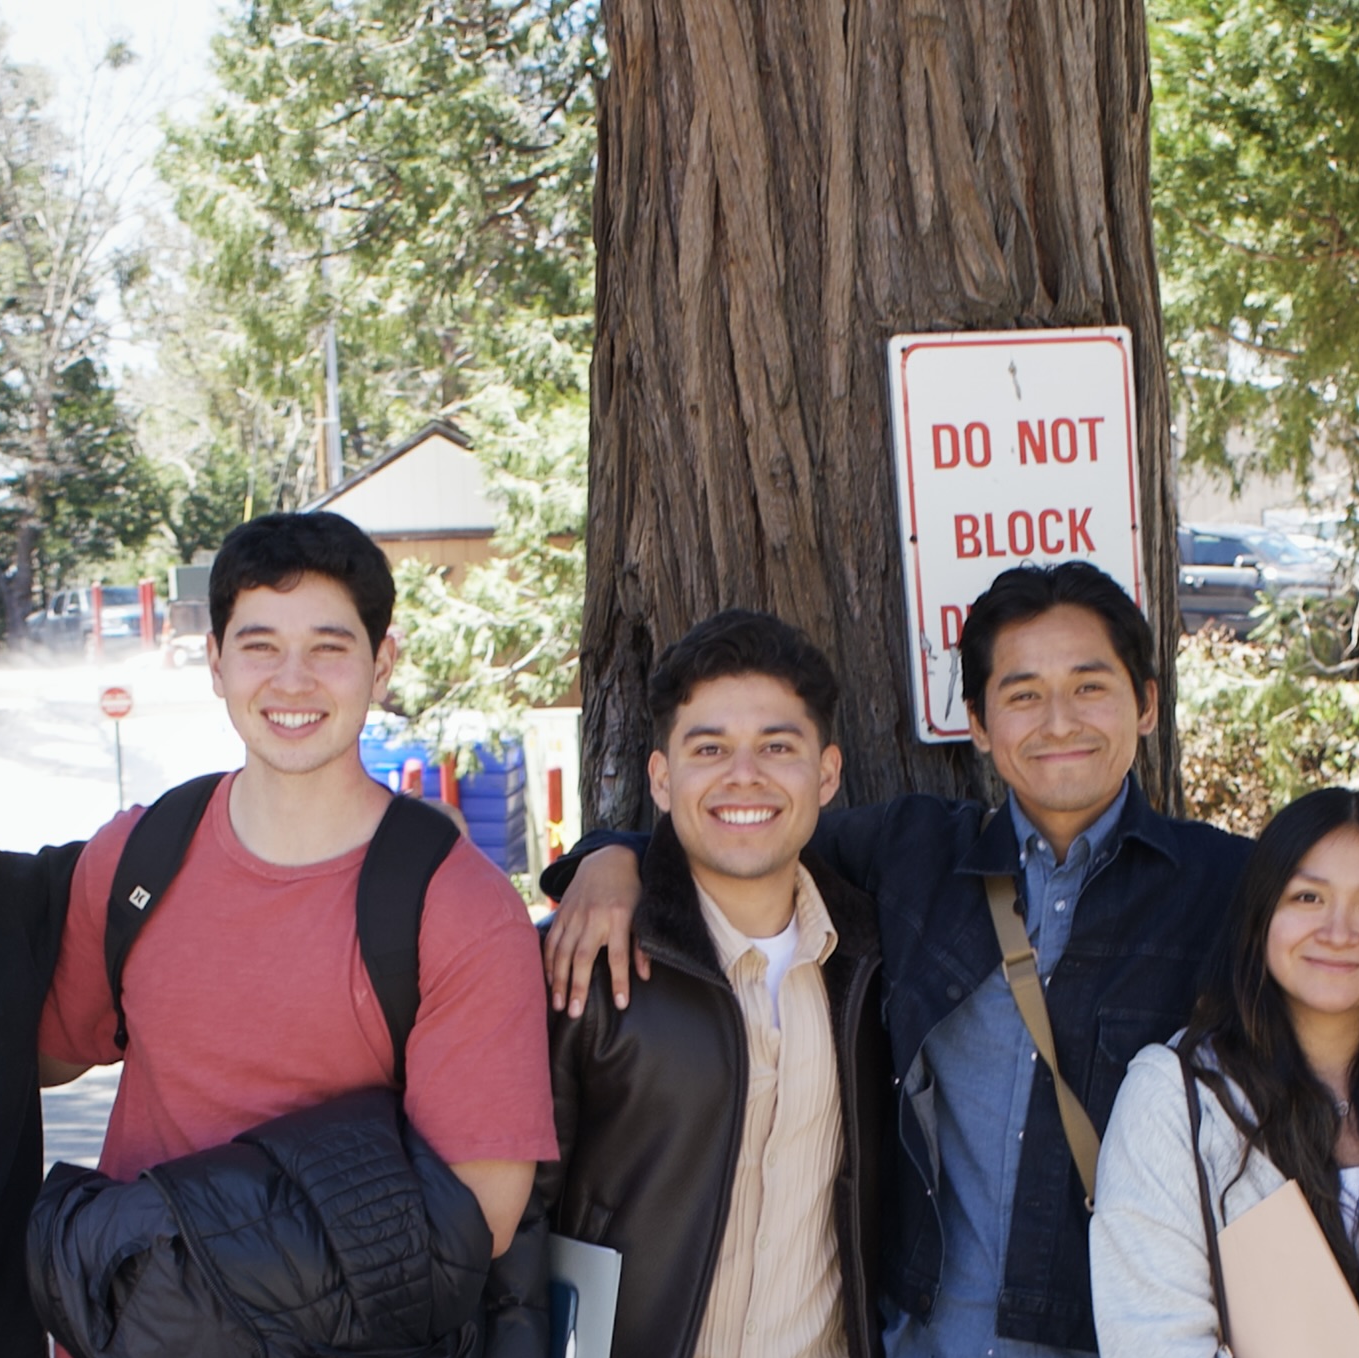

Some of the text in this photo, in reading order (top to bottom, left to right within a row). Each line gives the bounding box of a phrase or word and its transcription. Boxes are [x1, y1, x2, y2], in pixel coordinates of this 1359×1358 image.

[931, 416, 1105, 470] DO NOT
[953, 507, 1096, 560] BLOCK
